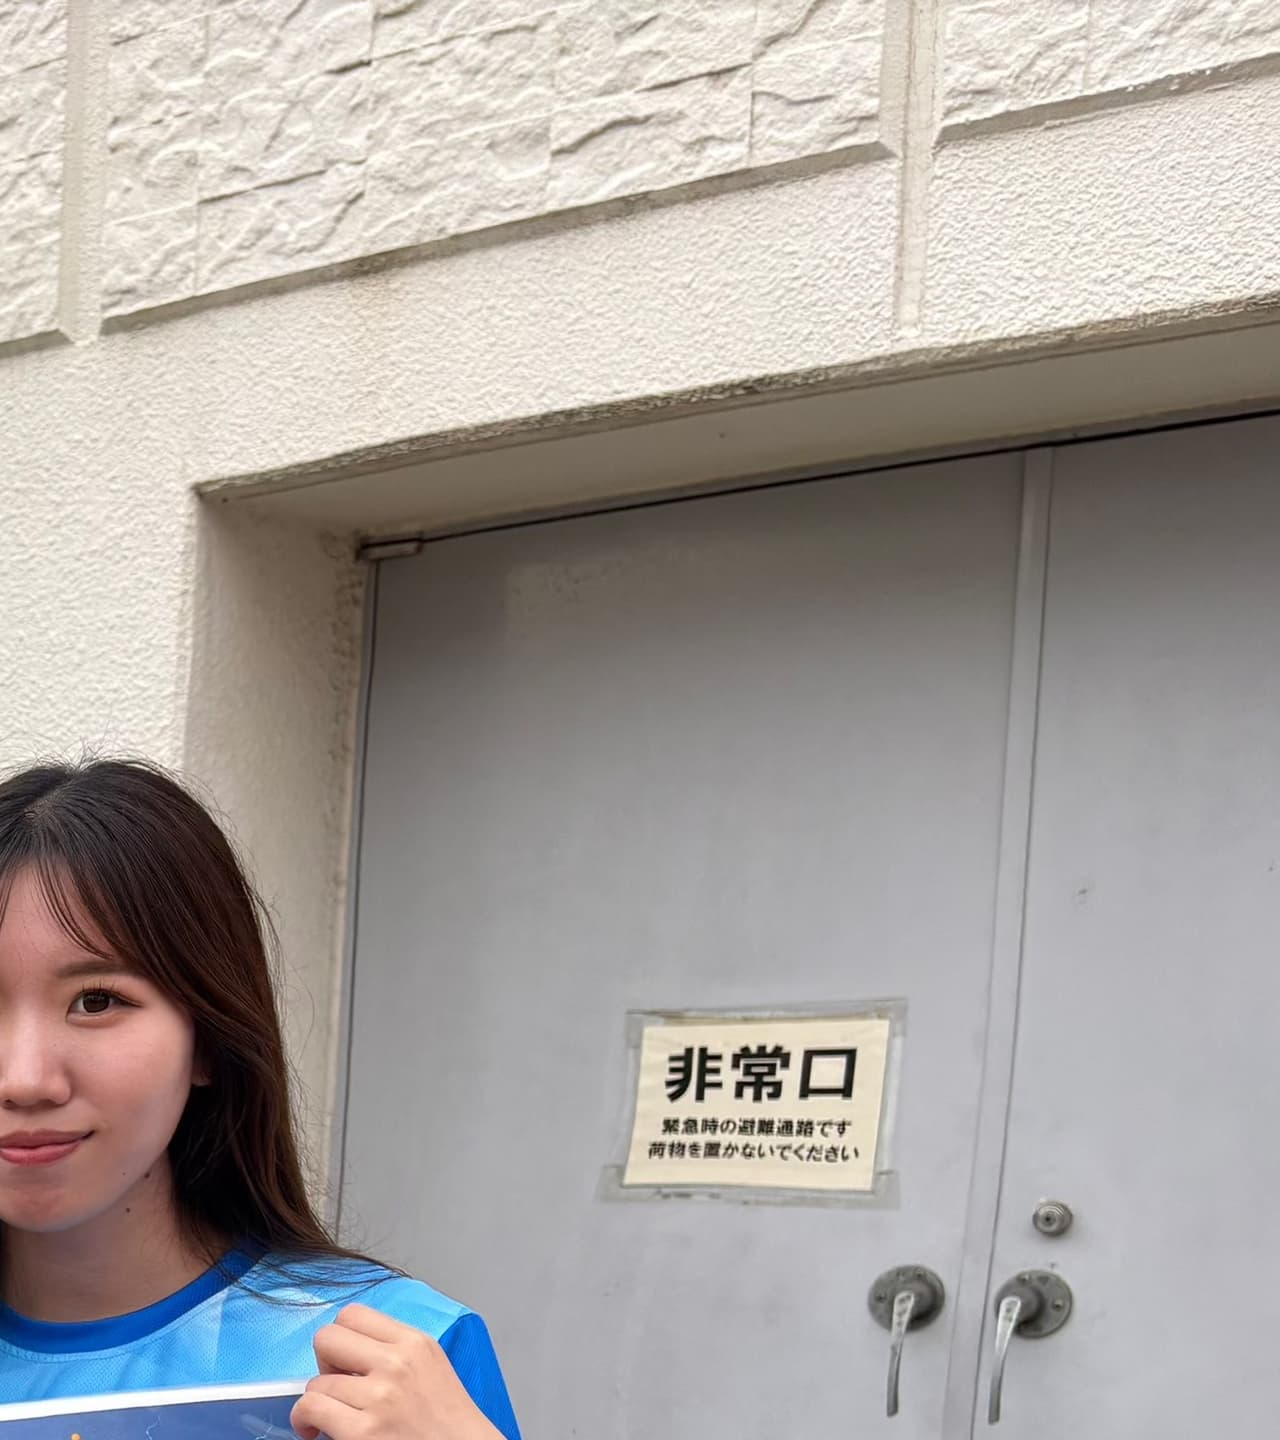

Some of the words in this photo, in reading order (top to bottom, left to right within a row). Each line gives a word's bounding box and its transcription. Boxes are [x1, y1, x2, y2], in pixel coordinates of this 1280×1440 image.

[665, 1044, 858, 1103] 非常口
[661, 1117, 852, 1139] 緊急時の避難通路です
[648, 1141, 860, 1163] 荷物を置かないでください
